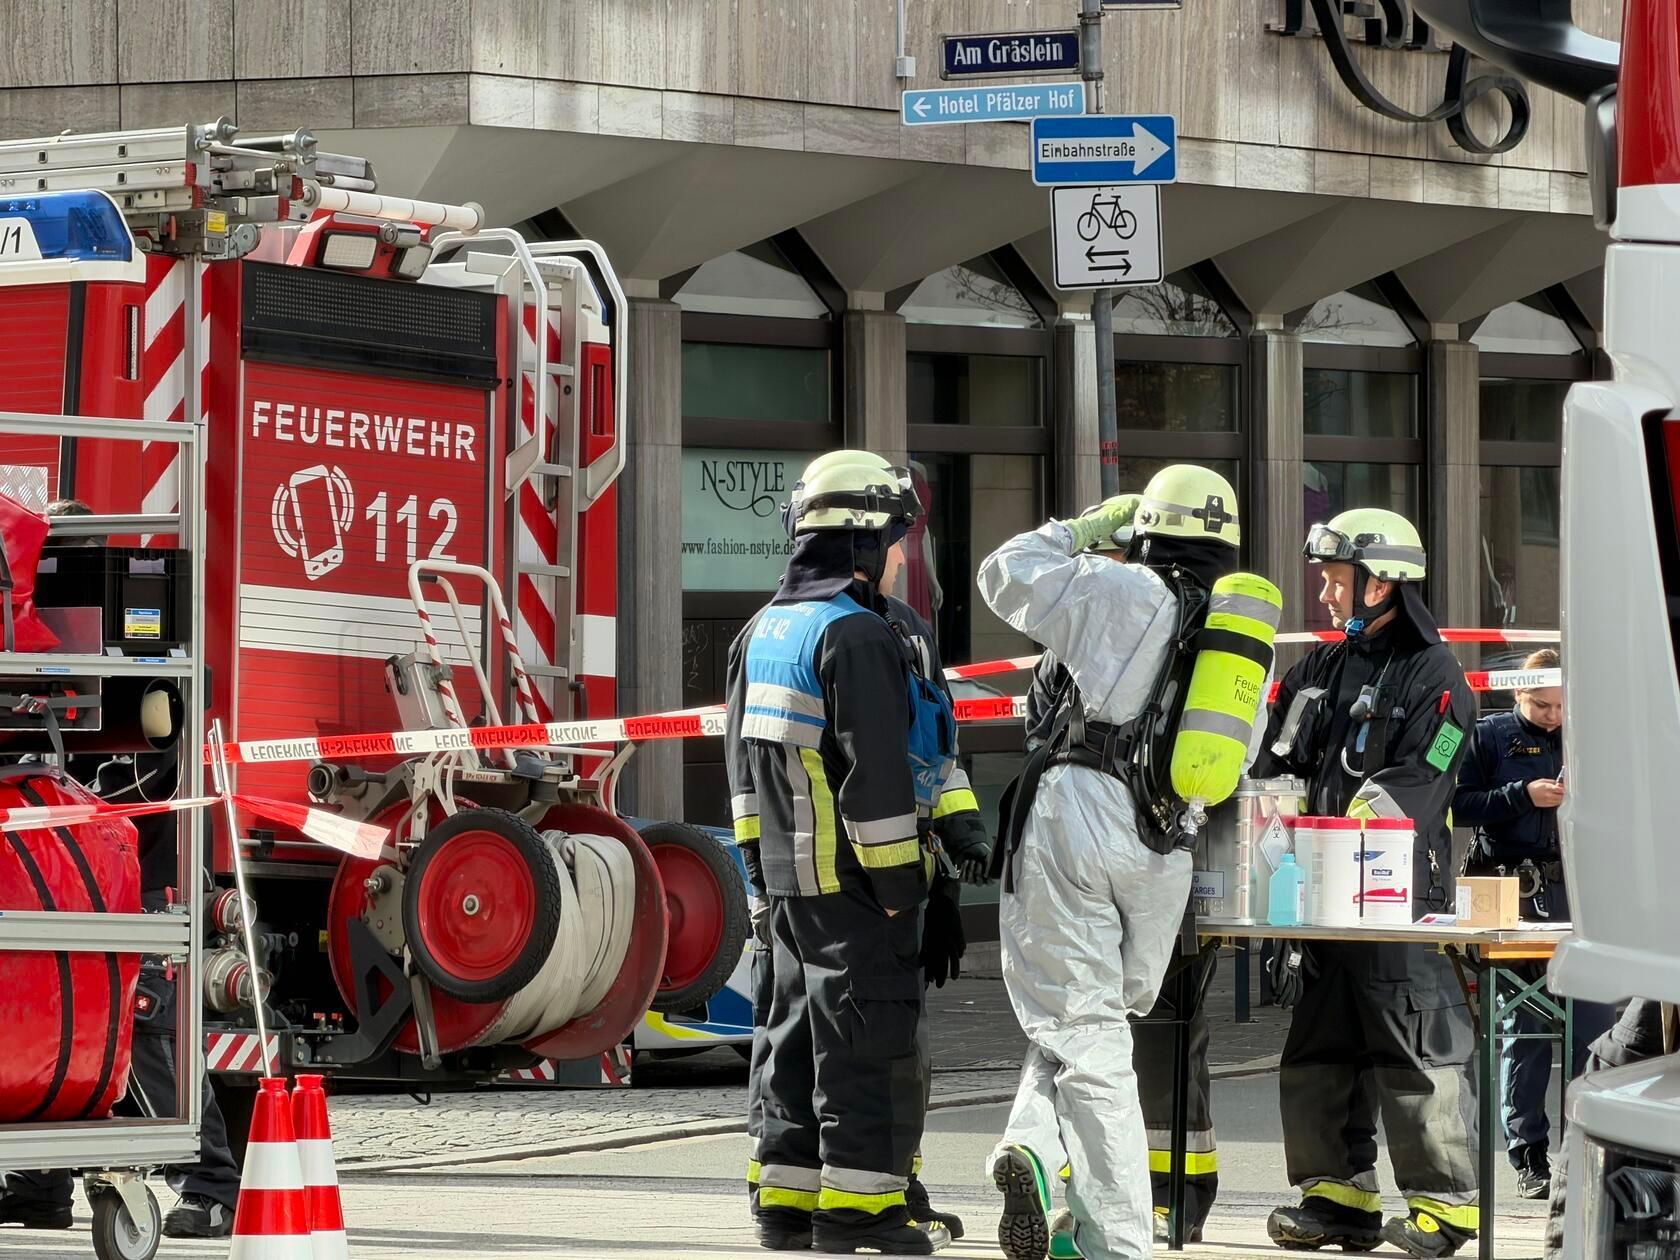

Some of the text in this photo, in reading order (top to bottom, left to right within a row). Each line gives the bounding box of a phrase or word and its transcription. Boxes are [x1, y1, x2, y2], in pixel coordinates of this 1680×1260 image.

[954, 37, 1063, 66] Am Gräslein
[939, 89, 1075, 115] Hotel Pfälzer Hof
[1041, 142, 1136, 158] Einbahnstraße
[253, 400, 476, 462] FEUERWEHR
[701, 460, 785, 517] N-STYLE
[871, 486, 877, 494] 4
[1212, 497, 1218, 507] 4
[365, 491, 458, 565] 112
[1374, 534, 1381, 543] 3
[681, 538, 796, 560] www.fashion-nstyle.de
